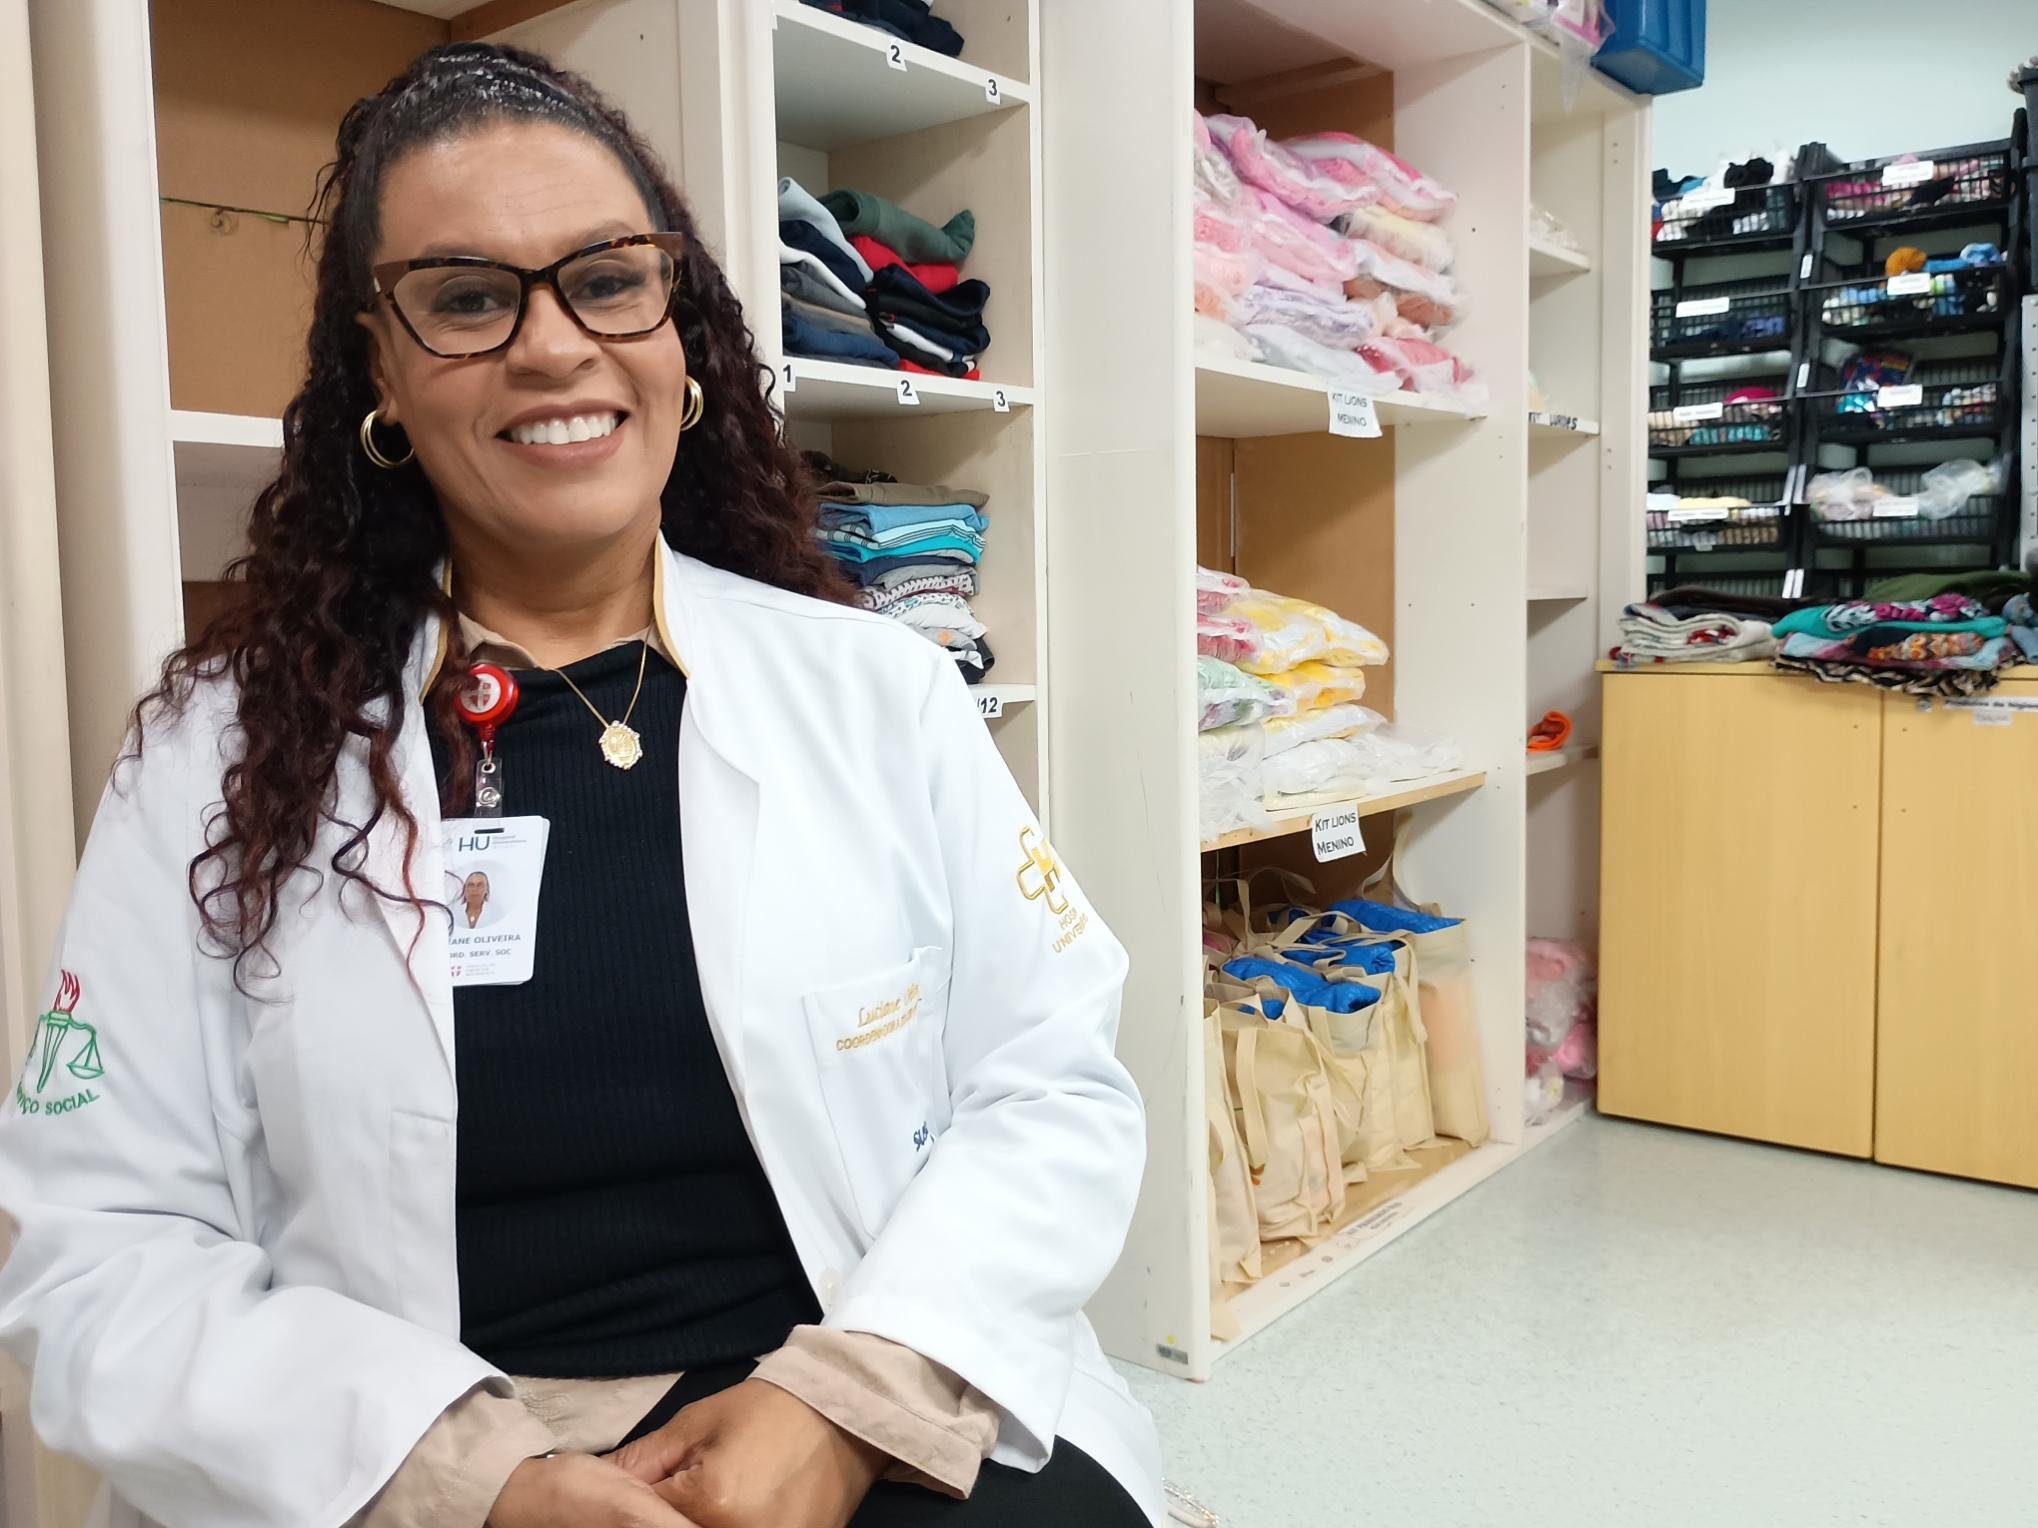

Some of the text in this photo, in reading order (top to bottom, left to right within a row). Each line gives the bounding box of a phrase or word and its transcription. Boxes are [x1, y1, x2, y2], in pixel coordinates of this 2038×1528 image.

[890, 45, 902, 64] 2
[988, 79, 998, 96] 3
[782, 365, 792, 383] 1
[900, 380, 912, 396] 2
[996, 391, 1006, 407] 3
[1315, 812, 1356, 832] KIT LIONS
[458, 835, 490, 852] HU
[1316, 836, 1355, 855] MENINO
[474, 934, 521, 944] OLIVEIRA
[45, 1088, 100, 1116] SOCIAL
